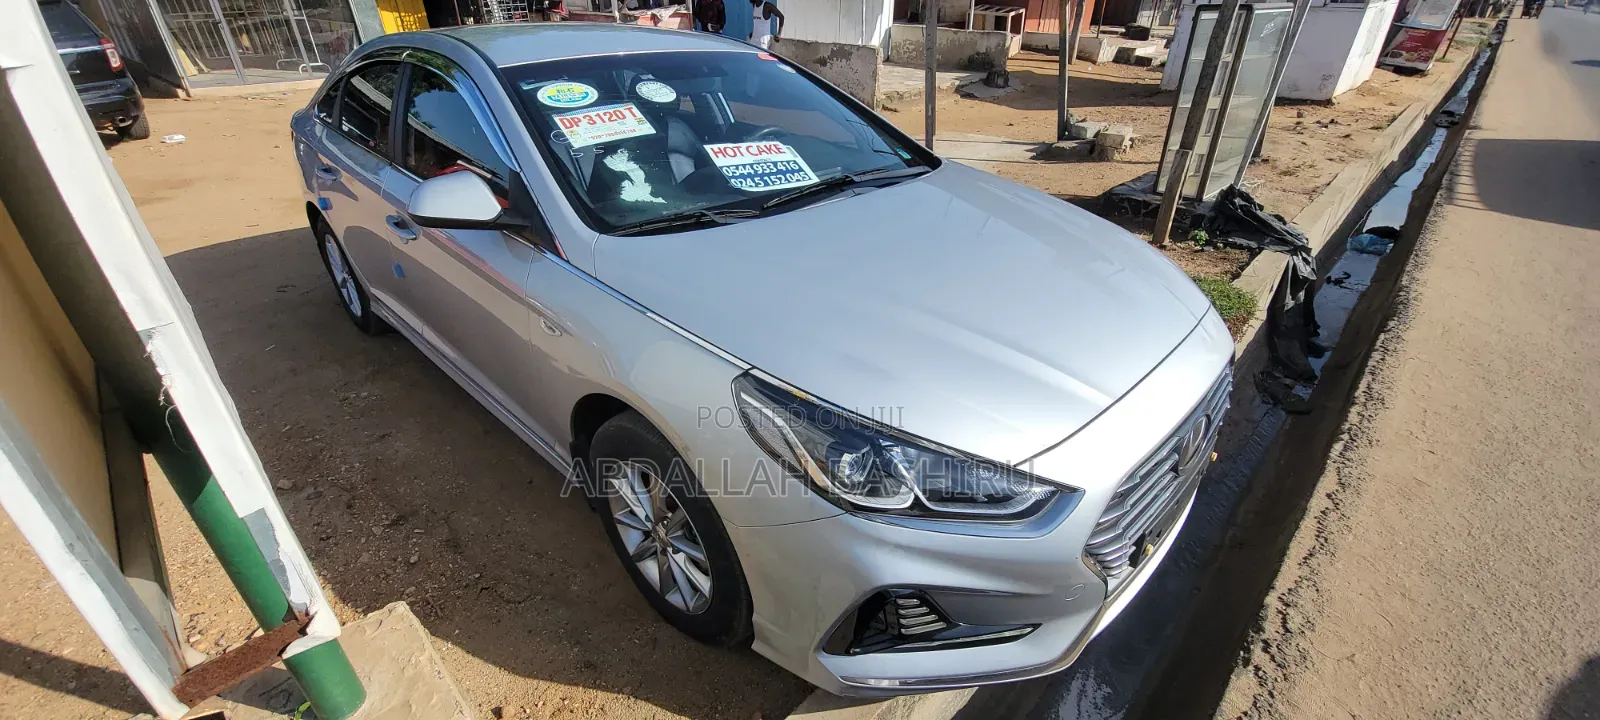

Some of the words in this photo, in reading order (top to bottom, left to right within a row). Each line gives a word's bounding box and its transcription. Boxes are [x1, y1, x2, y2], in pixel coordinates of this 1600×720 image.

[558, 116, 582, 130] DP
[583, 109, 626, 125] 3120
[624, 107, 638, 118] T
[709, 145, 745, 159] HOT
[745, 143, 787, 157] CAKE
[722, 165, 755, 177] 0544
[754, 162, 778, 174] 933
[777, 161, 799, 171] 416
[730, 176, 765, 188] 0245
[764, 174, 788, 186] 152
[787, 171, 810, 182] 045
